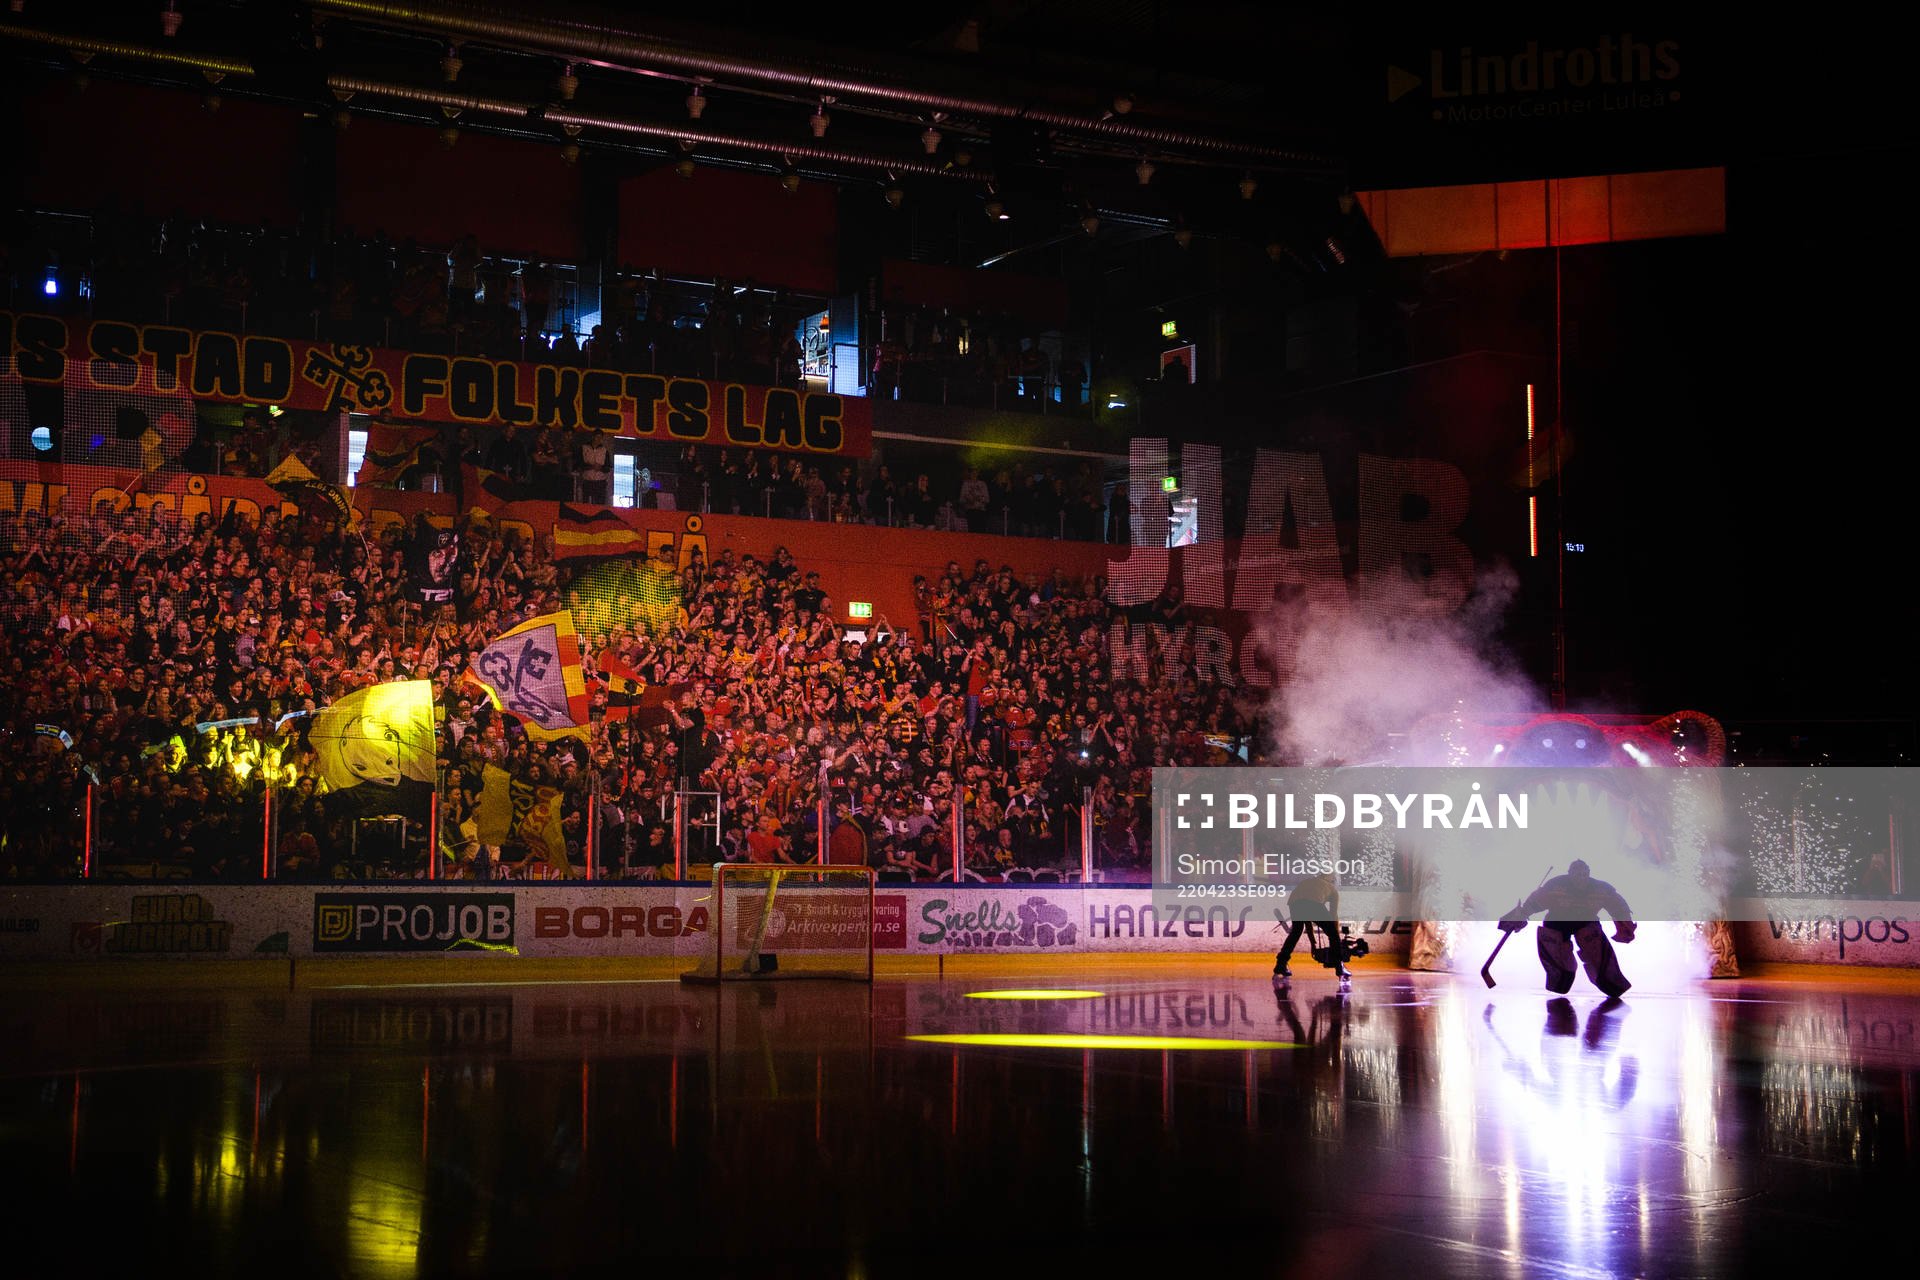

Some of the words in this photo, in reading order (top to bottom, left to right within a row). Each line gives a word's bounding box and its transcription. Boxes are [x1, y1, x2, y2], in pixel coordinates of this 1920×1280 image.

[1430, 33, 1681, 99] Lindroths
[87, 319, 295, 402] STAD
[403, 352, 710, 440] FOLKETS
[724, 383, 845, 453] LAG
[131, 895, 204, 922] EURO
[354, 904, 512, 941] PROJOB
[918, 899, 1021, 945] Snells
[106, 921, 231, 952] JACKPOT
